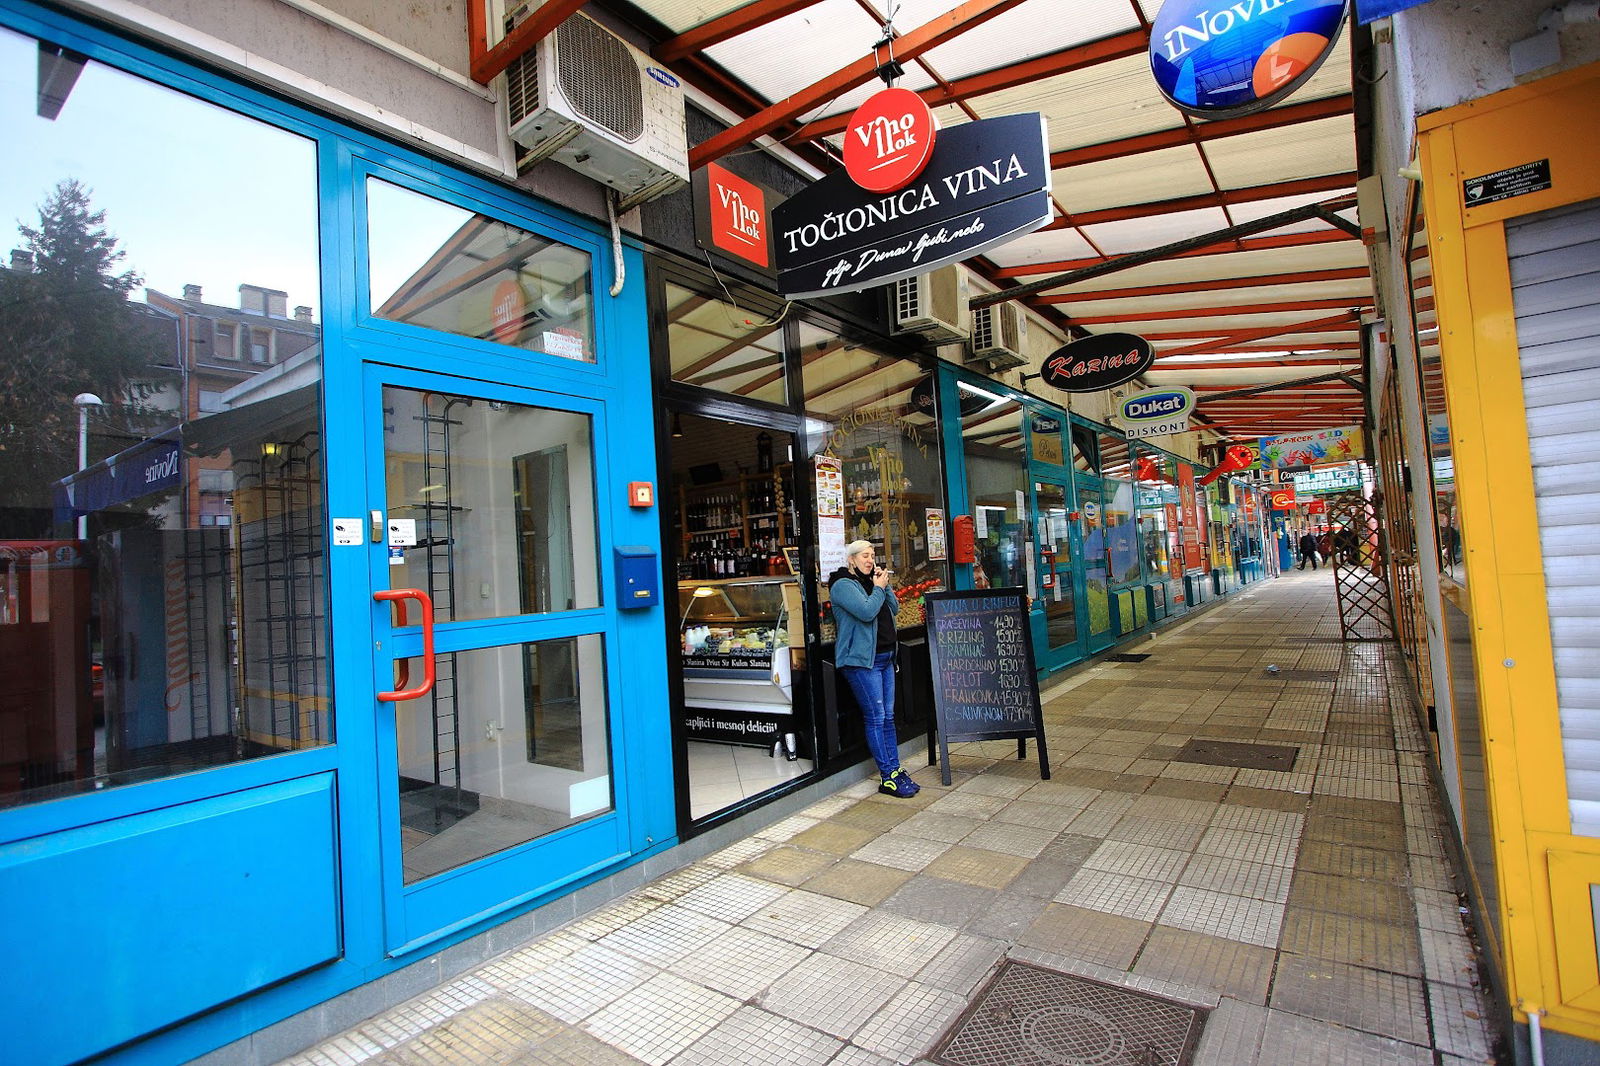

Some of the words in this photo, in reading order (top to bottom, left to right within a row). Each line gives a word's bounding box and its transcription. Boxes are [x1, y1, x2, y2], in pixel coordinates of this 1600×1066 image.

[784, 183, 940, 253] TOČIONICA
[942, 153, 1028, 200] VINA
[851, 240, 912, 277] Dunav
[911, 229, 948, 263] ljubi
[946, 216, 985, 243] nebo
[1128, 396, 1181, 416] Dukat
[1127, 421, 1187, 438] DISKONT
[943, 671, 983, 689] MERLOT
